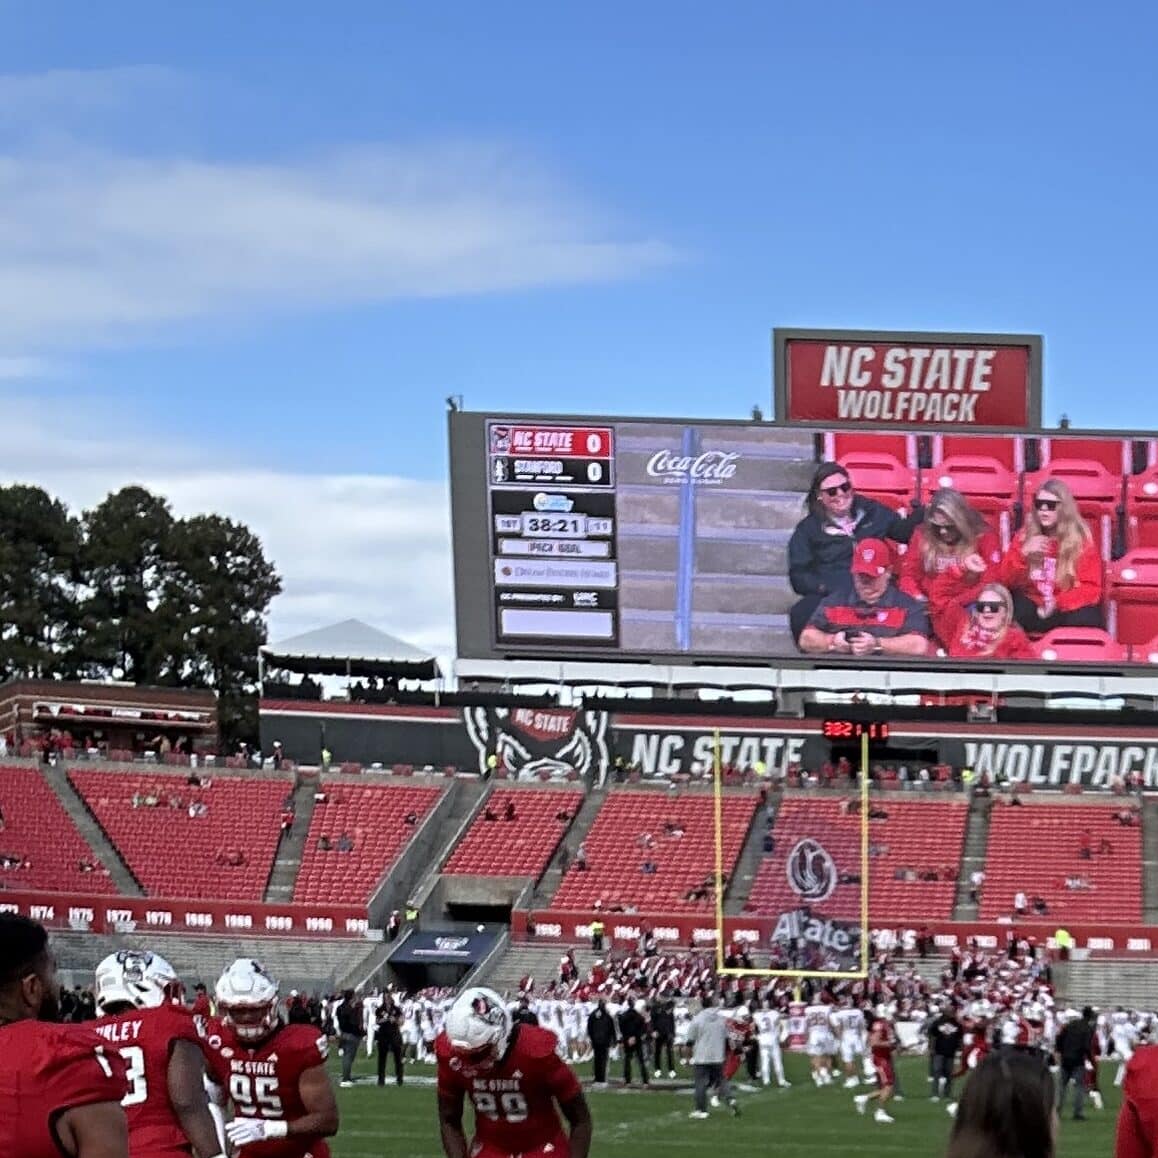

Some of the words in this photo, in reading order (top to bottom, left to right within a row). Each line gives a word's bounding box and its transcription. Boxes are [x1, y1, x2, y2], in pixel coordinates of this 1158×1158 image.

[820, 346, 876, 387] NC
[881, 348, 996, 391] STATE
[837, 389, 979, 422] WOLFPACK
[513, 431, 532, 447] NC
[533, 432, 574, 448] STATE
[586, 433, 602, 453] 0
[587, 462, 602, 482] 0
[515, 708, 534, 726] NC
[534, 712, 571, 733] STATE
[632, 733, 685, 774] NC
[692, 735, 807, 777] STATE
[245, 1061, 276, 1075] STATE
[230, 1073, 284, 1118] 95
